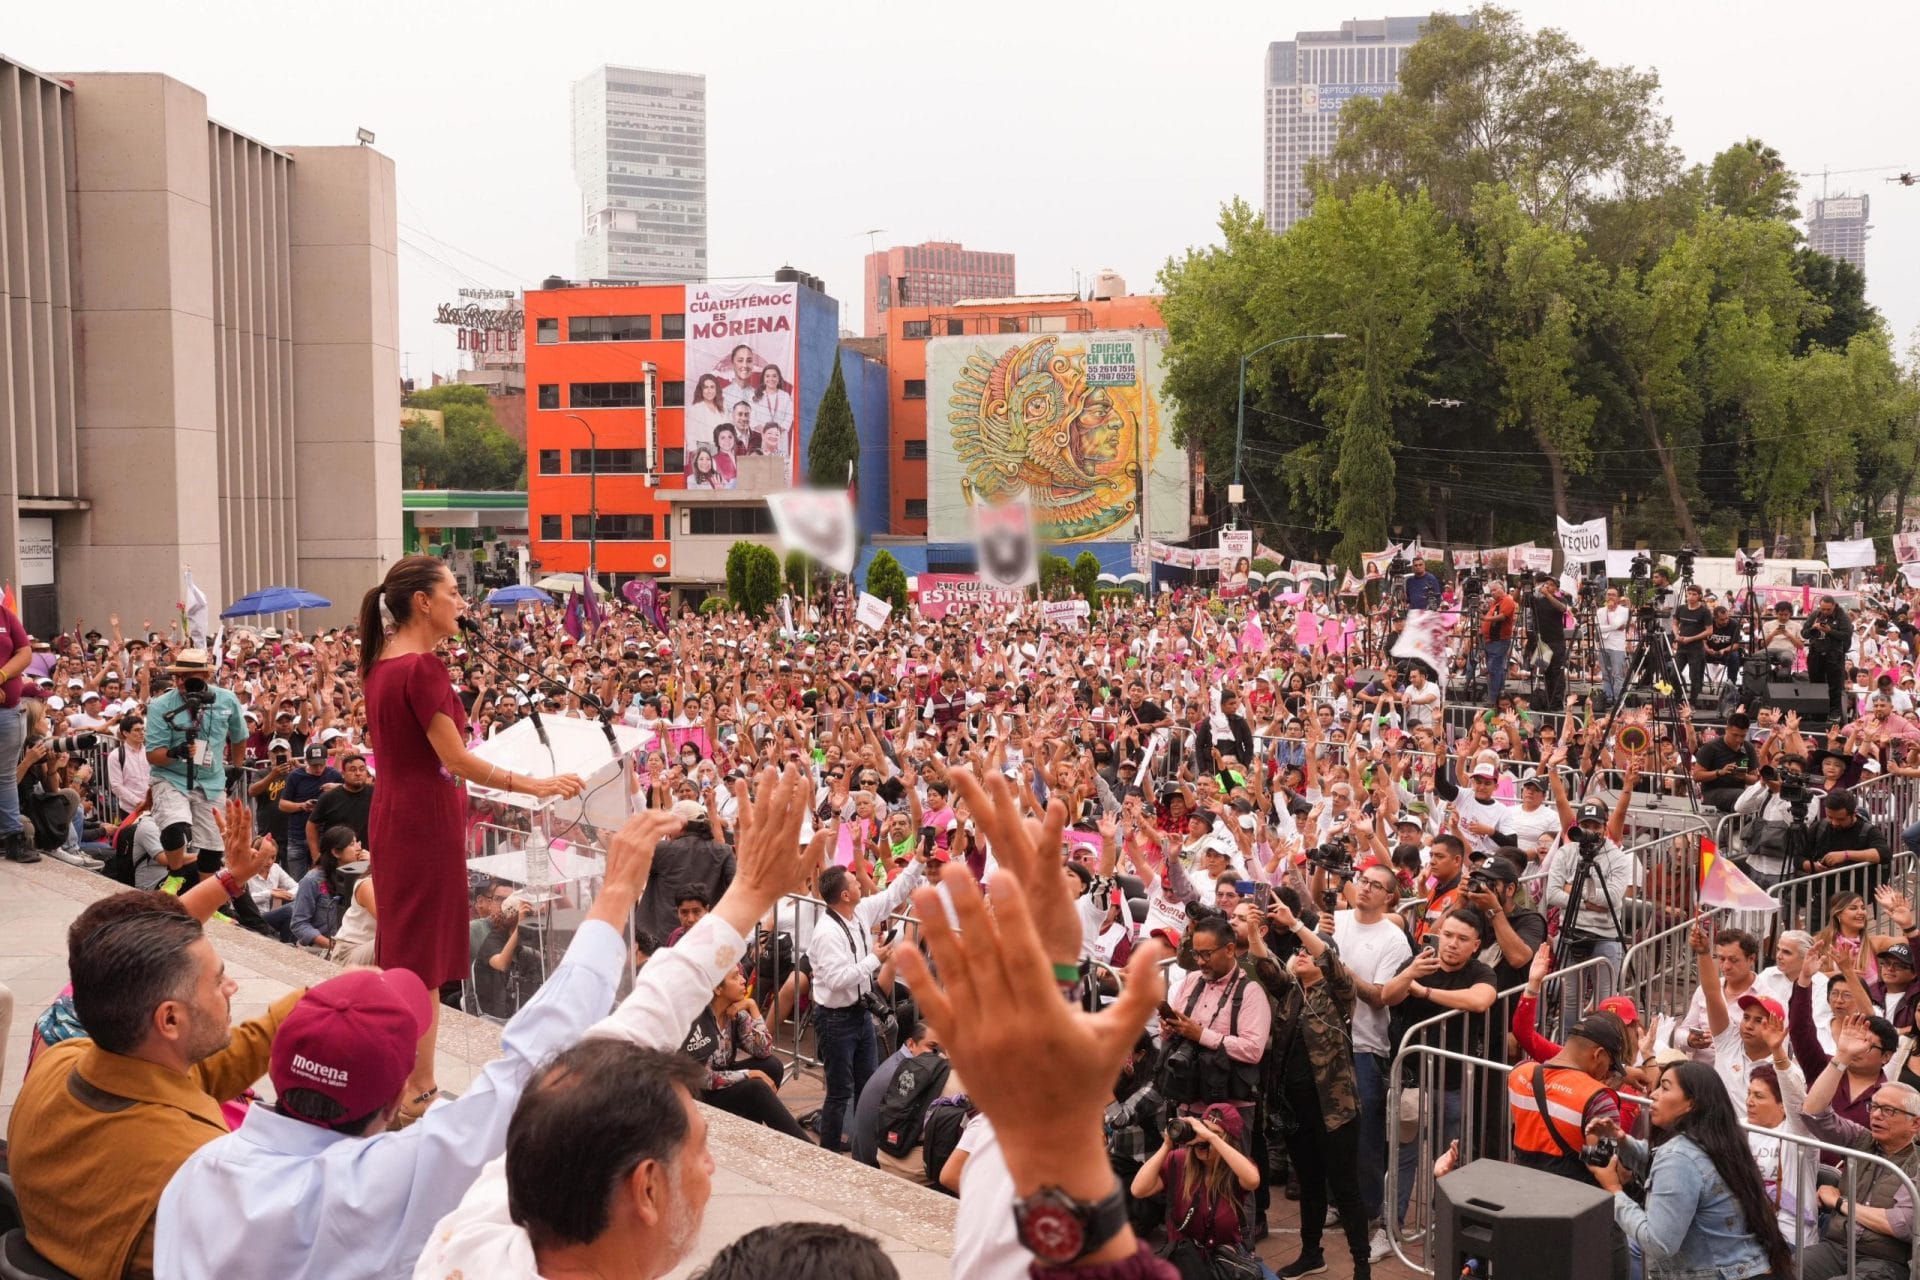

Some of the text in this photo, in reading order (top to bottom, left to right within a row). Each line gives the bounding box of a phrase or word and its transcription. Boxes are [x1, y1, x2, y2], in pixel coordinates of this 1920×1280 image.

[690, 294, 792, 313] CUAUHTÉMOC
[696, 292, 709, 300] LA
[713, 313, 726, 321] ES
[693, 316, 789, 339] MORENA
[1091, 343, 1132, 353] EDIFICIO
[1087, 353, 1135, 365] EN VENTA
[1561, 534, 1600, 552] TEQUIO
[922, 589, 993, 604] ESTHER
[1482, 857, 1495, 869] C
[1155, 897, 1186, 920] morena
[686, 1036, 711, 1052] adidas
[292, 1054, 348, 1081] morena
[1552, 1083, 1574, 1094] CIVIL
